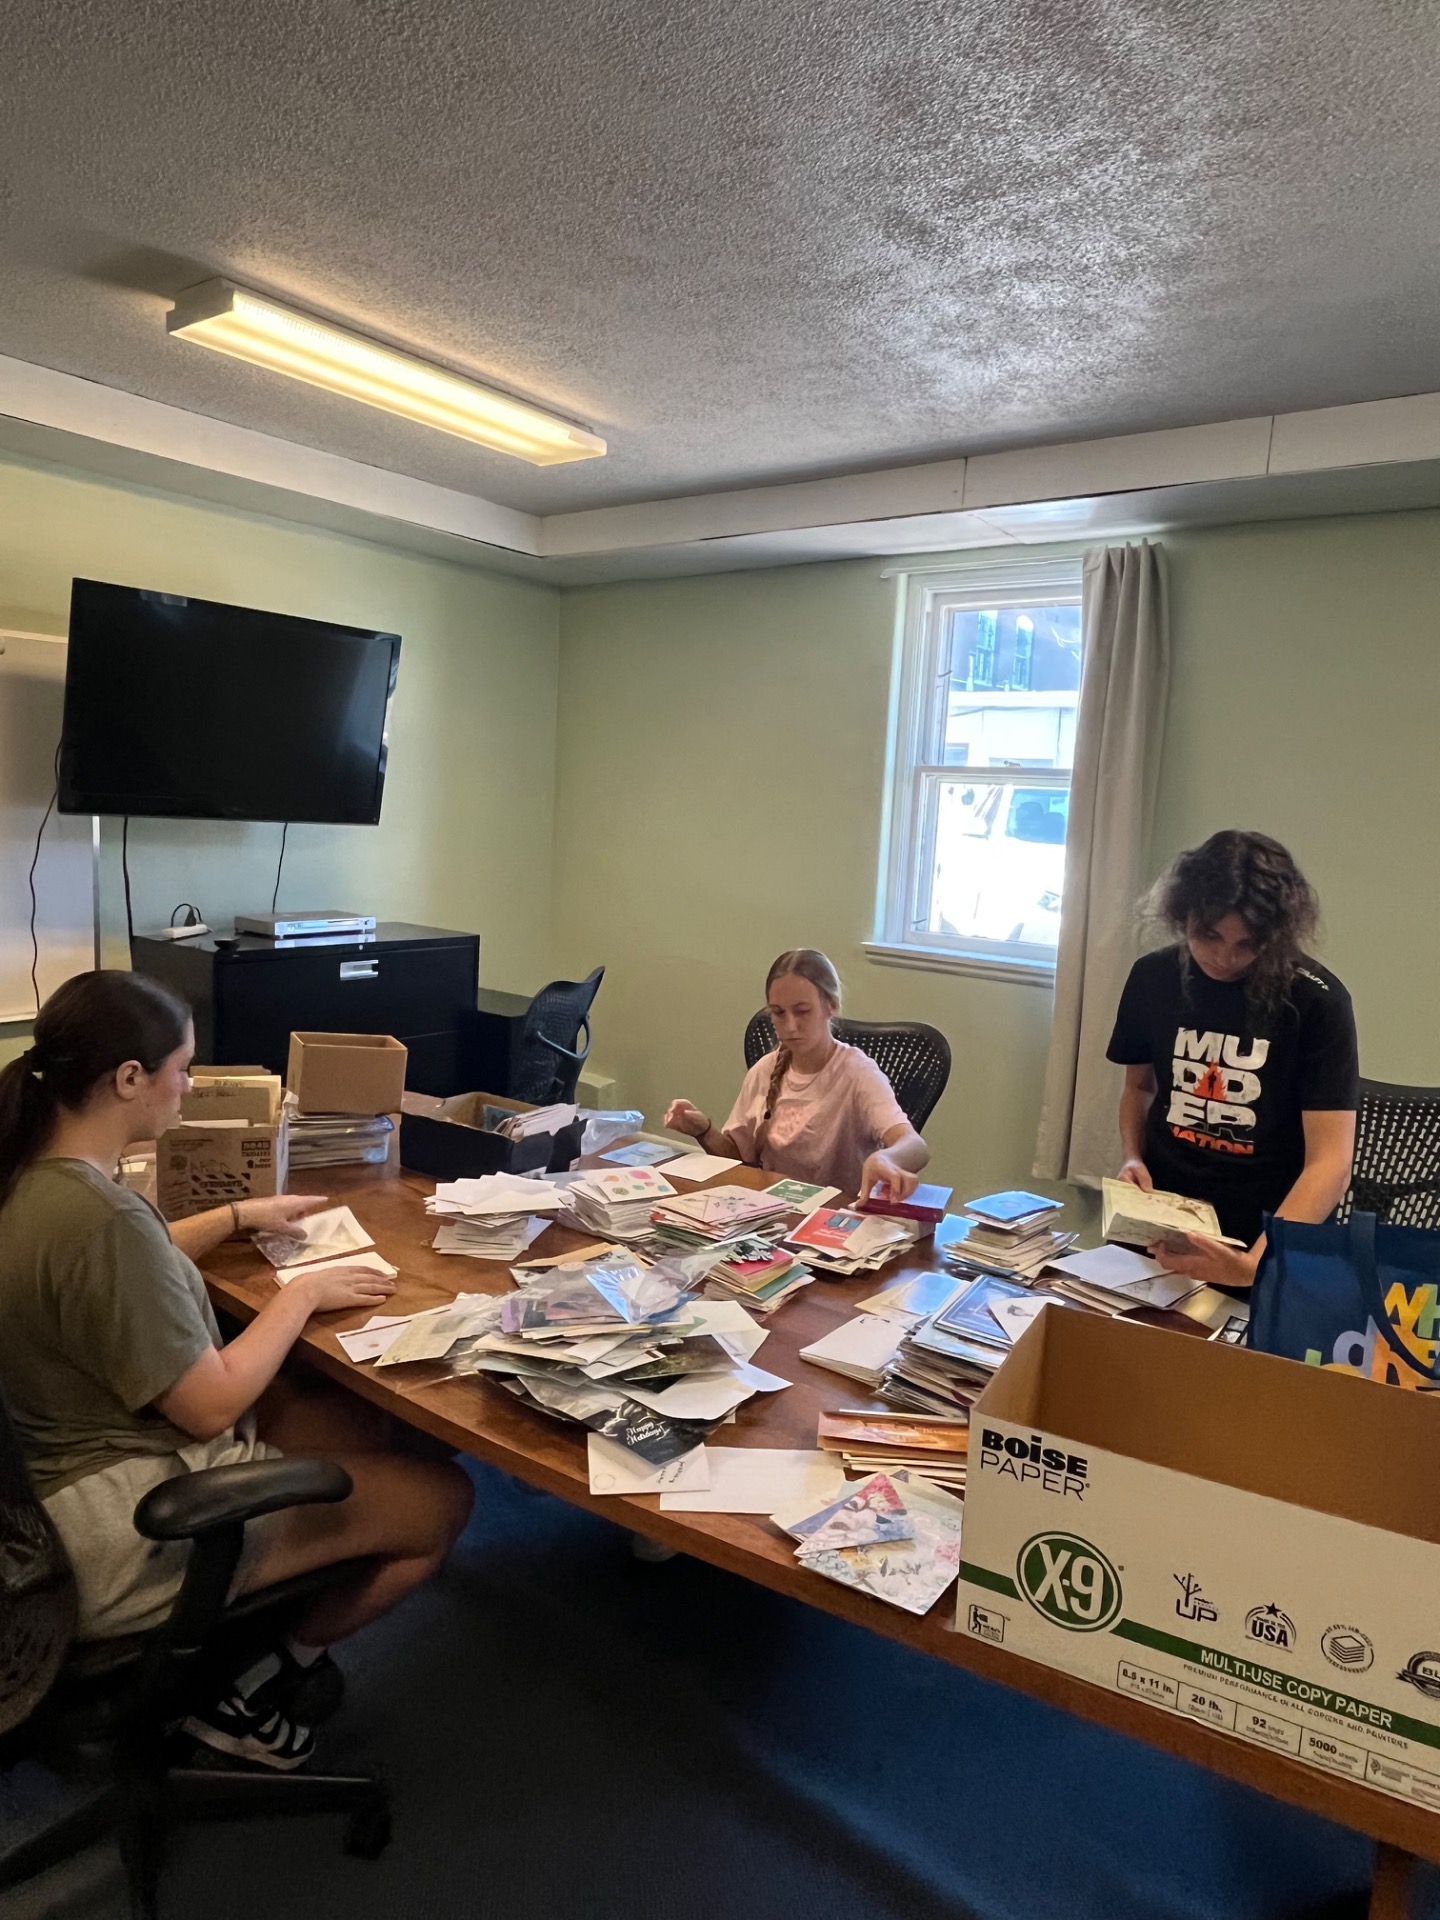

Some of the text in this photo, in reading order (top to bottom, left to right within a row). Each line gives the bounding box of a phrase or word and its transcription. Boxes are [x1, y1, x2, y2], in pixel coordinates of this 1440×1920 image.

[626, 1422, 655, 1435] Happy
[981, 1450, 1085, 1501] PAPER
[1033, 1542, 1104, 1620] X-9
[1251, 1619, 1288, 1647] USA
[1149, 1678, 1160, 1689] 11
[1200, 1650, 1283, 1691] MULTI-USE
[1286, 1680, 1333, 1708] COPY
[1335, 1696, 1393, 1729] PAPER
[1191, 1693, 1206, 1706] 20
[1251, 1716, 1267, 1730] 92
[1308, 1737, 1337, 1755] 5000
